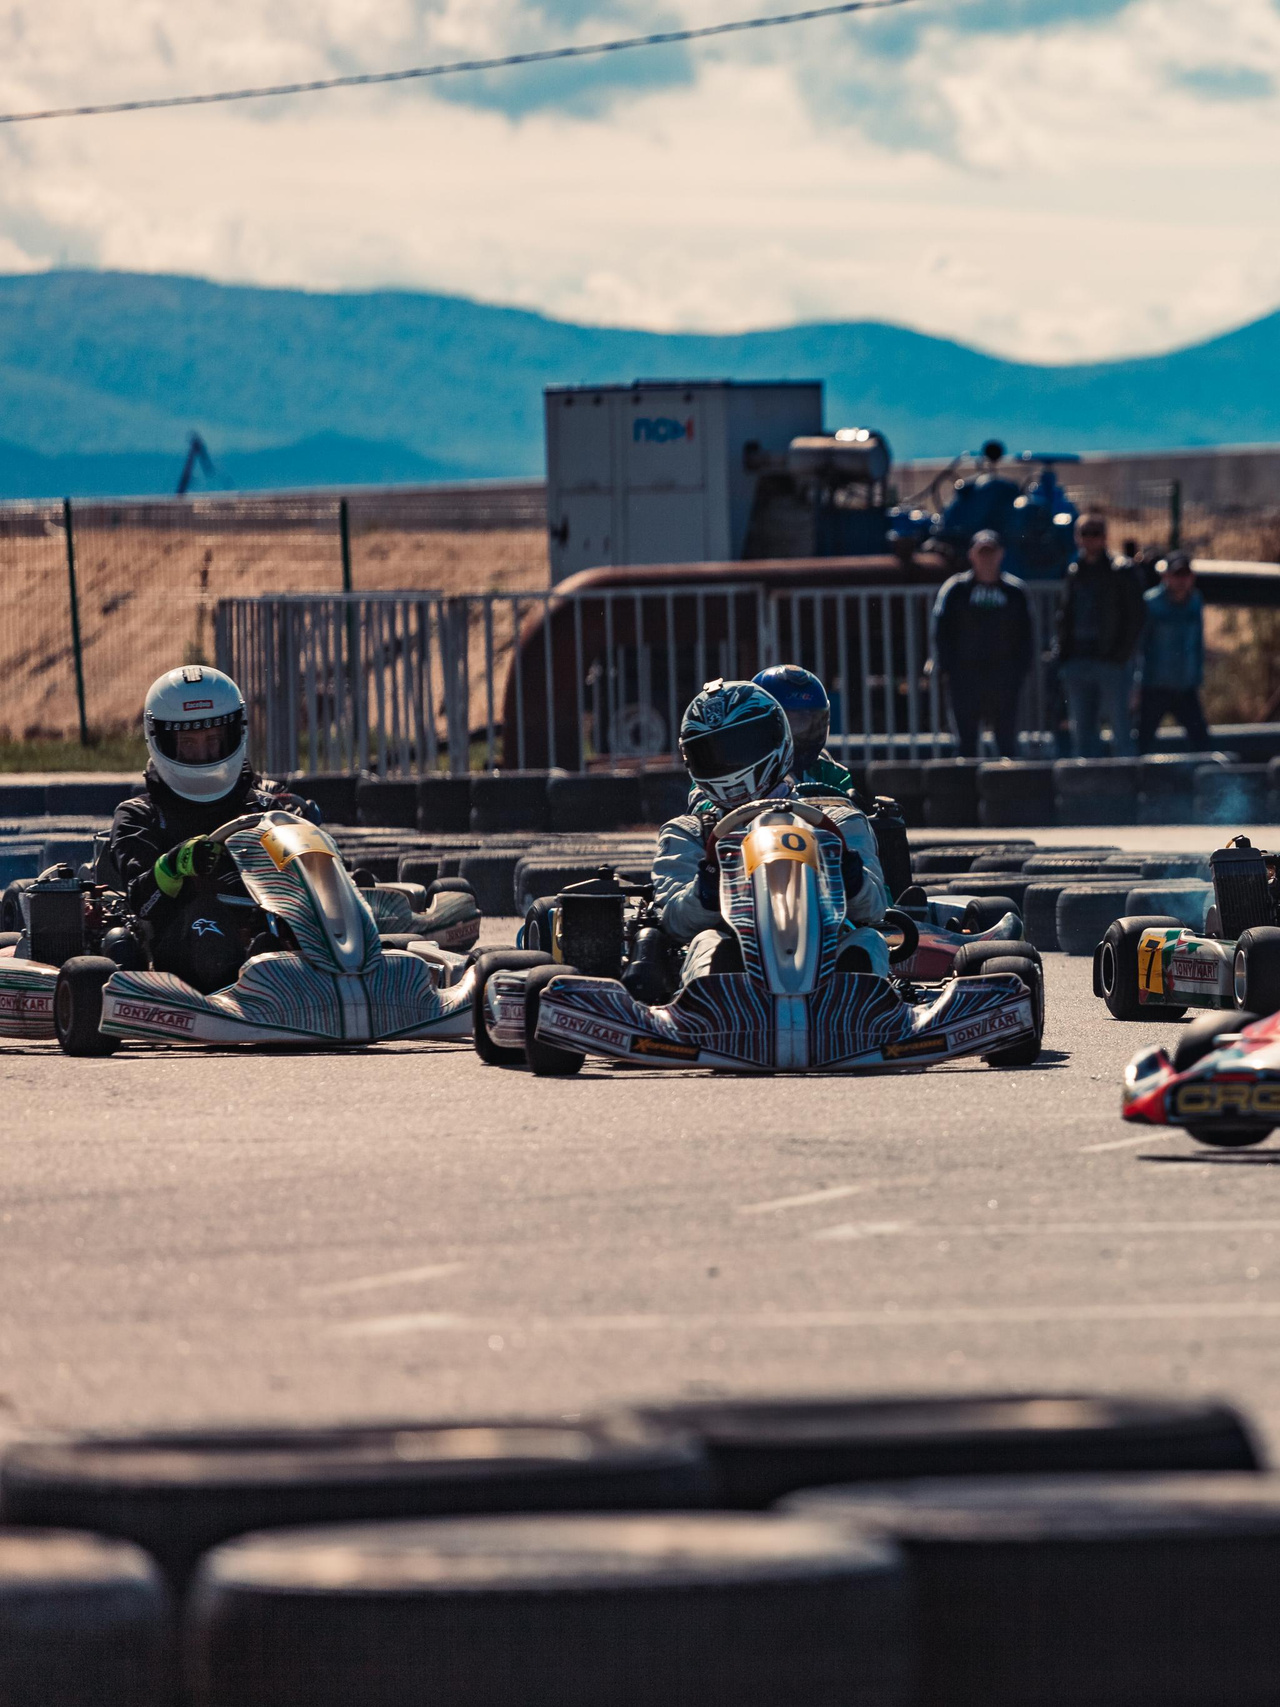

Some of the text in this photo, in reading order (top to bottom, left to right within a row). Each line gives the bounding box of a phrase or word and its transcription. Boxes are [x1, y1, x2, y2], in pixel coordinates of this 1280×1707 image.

[781, 832, 807, 852] 0
[1145, 939, 1160, 989] 7
[21, 998, 50, 1011] KART
[118, 1003, 192, 1027] TONY KART
[554, 1012, 626, 1043] TONY KART
[950, 1010, 1018, 1042] TONY KART
